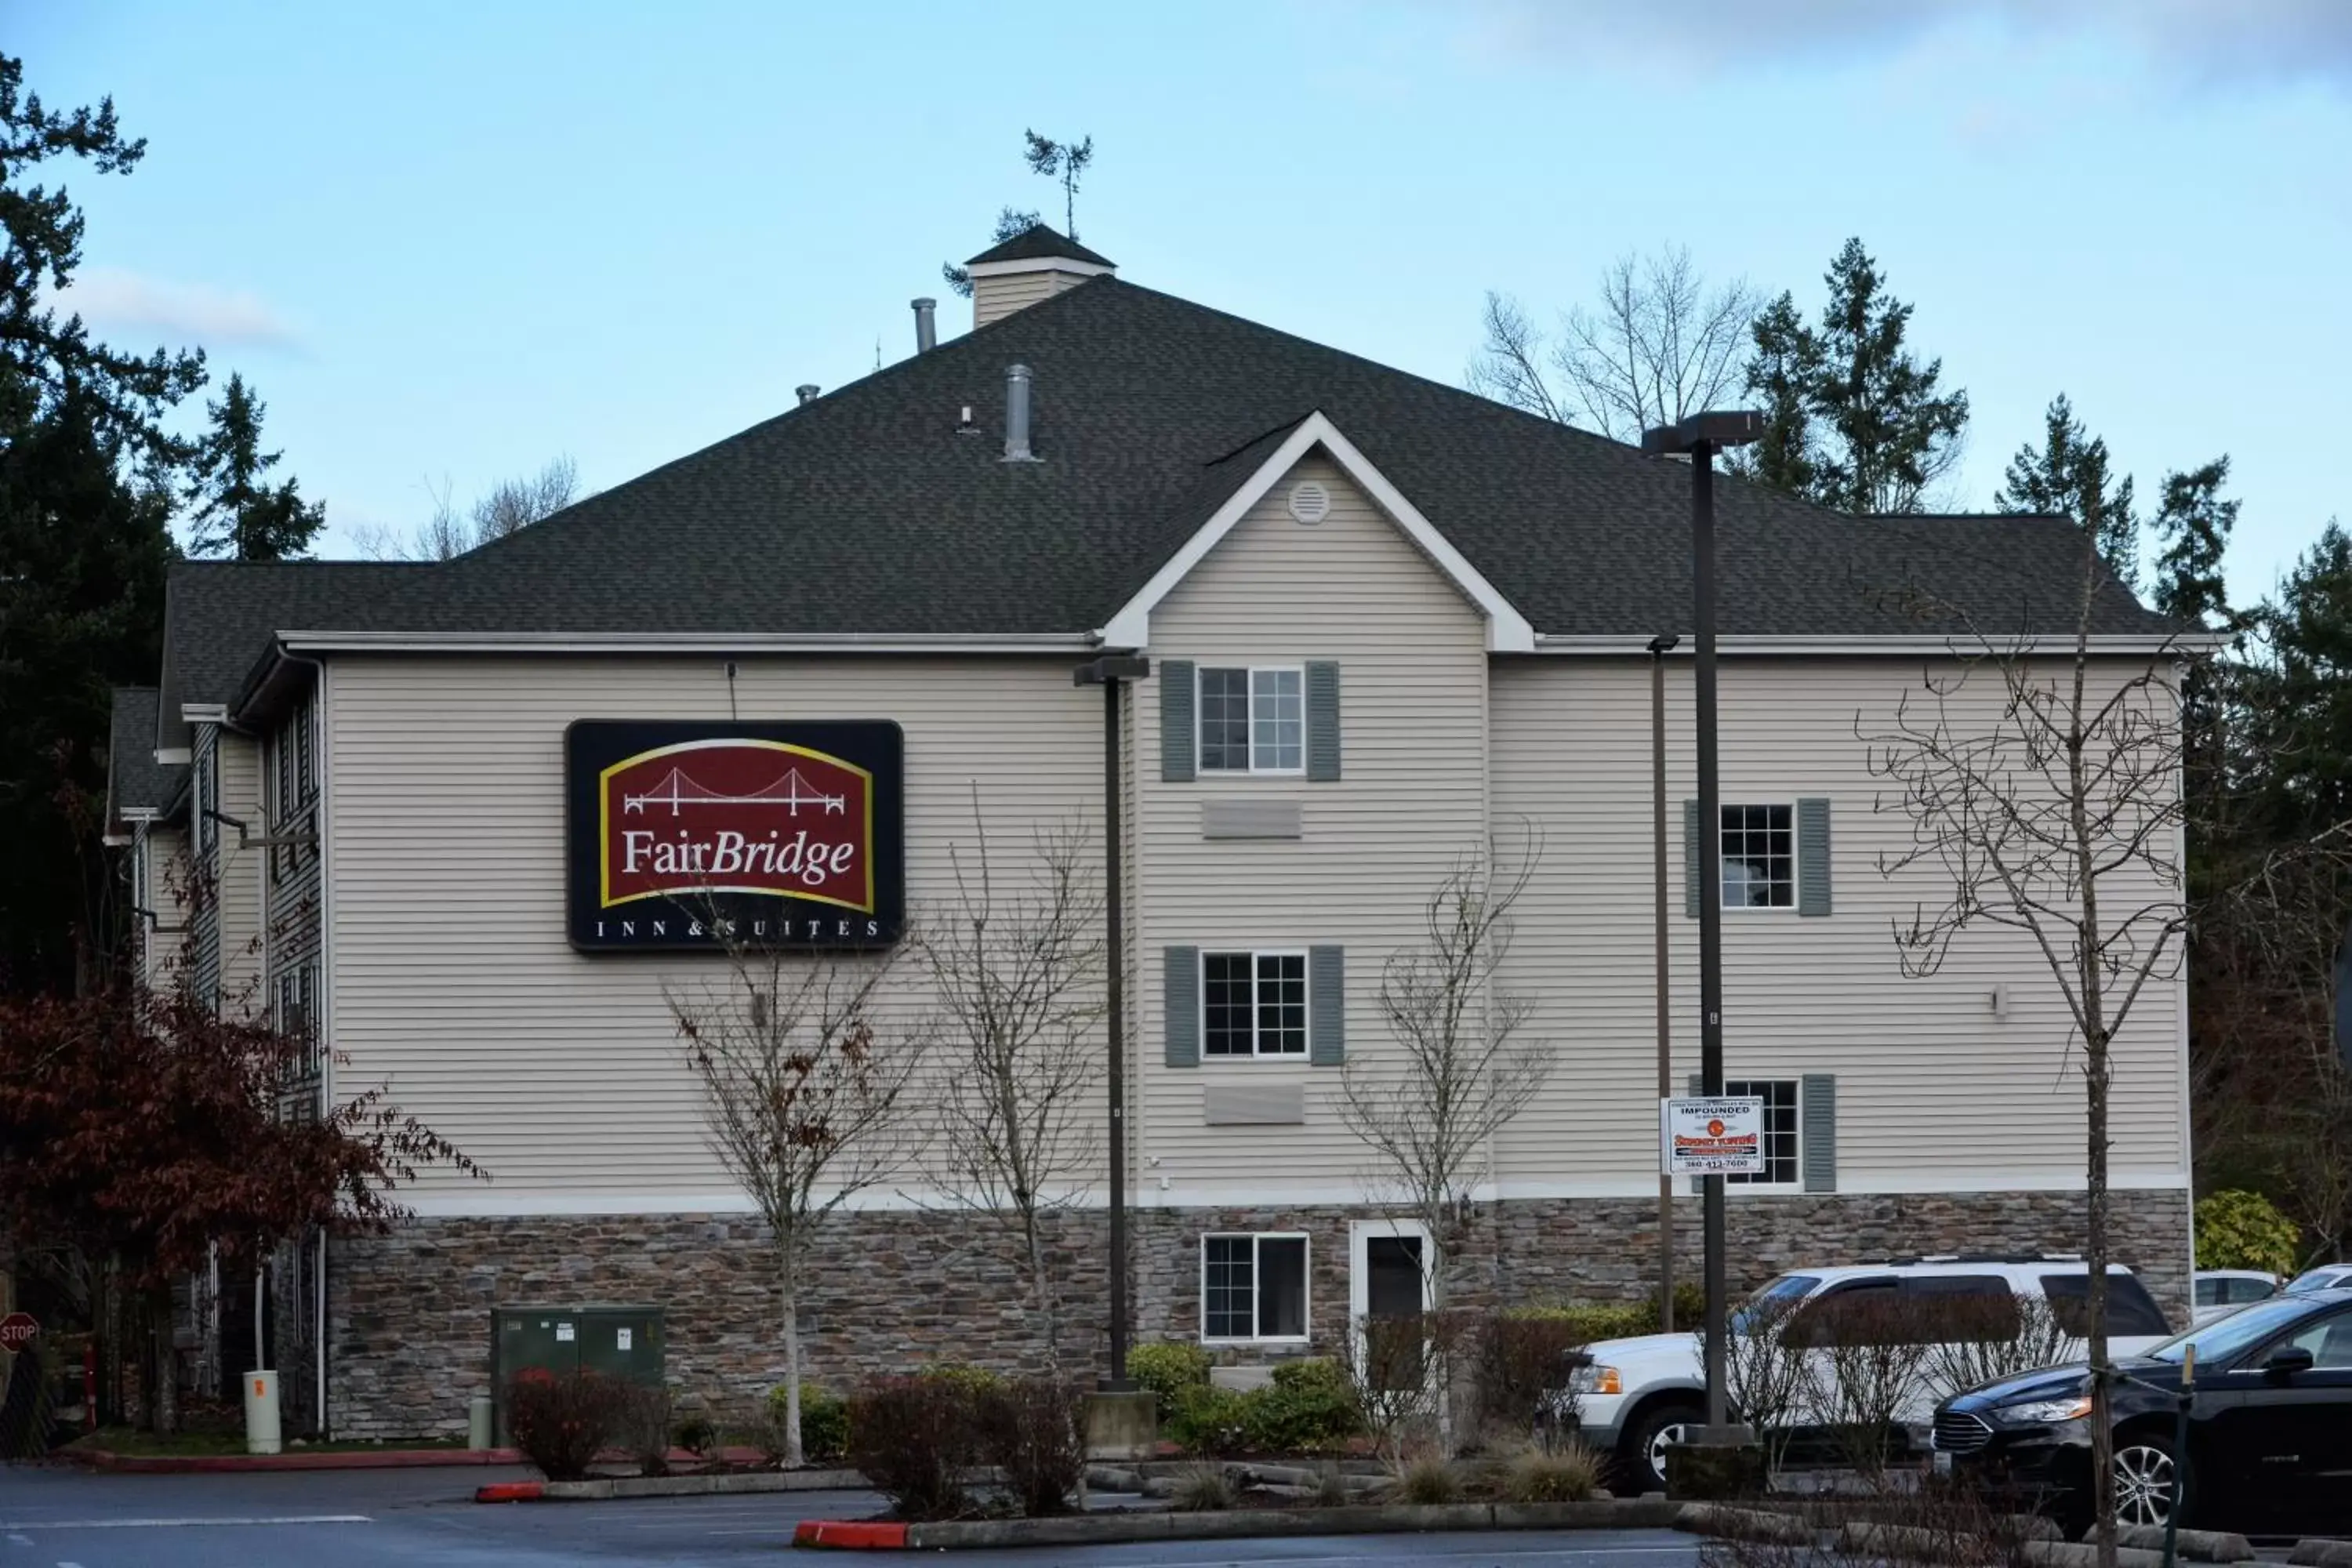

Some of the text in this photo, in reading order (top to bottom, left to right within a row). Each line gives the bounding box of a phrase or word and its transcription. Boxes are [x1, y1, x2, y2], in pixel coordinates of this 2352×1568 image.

[622, 830, 854, 885] FairBridge
[596, 920, 877, 937] INN & SUITES
[1681, 1106, 1750, 1115] IMPOUNDED
[2, 1325, 35, 1341] STOP
